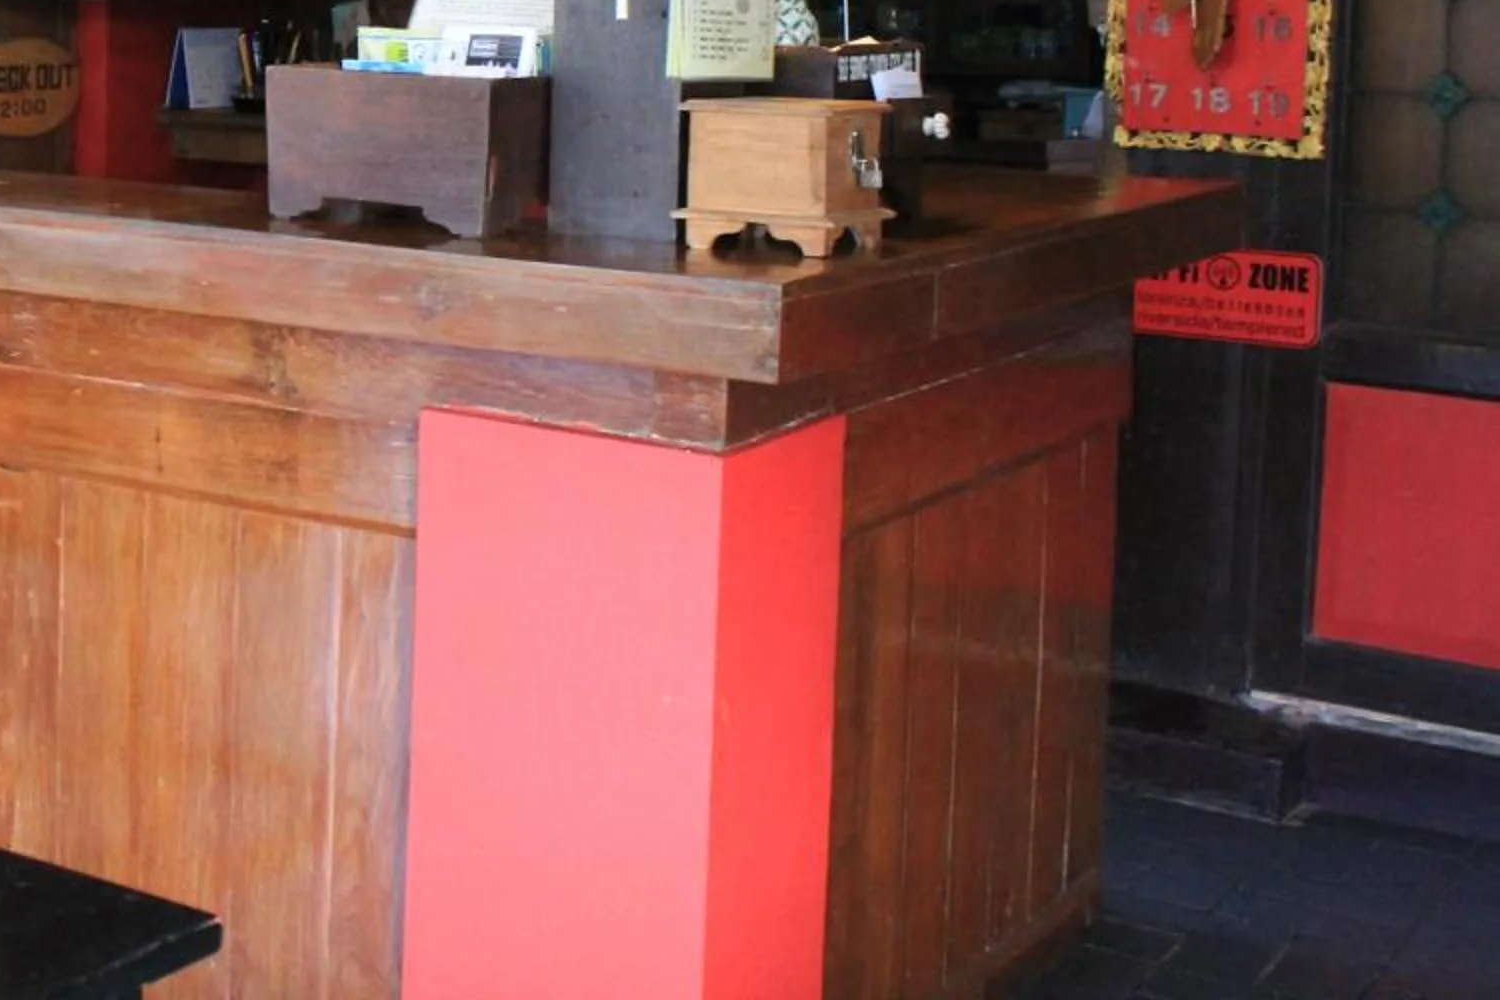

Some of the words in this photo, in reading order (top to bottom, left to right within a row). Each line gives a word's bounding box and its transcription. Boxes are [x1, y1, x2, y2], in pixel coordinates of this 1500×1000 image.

[1136, 12, 1172, 37] 14
[1254, 15, 1294, 42] 16
[35, 63, 77, 90] OUT
[1127, 82, 1169, 109] 17
[1189, 86, 1232, 114] 18
[1246, 89, 1290, 118] 19
[1247, 263, 1309, 293] ZONE
